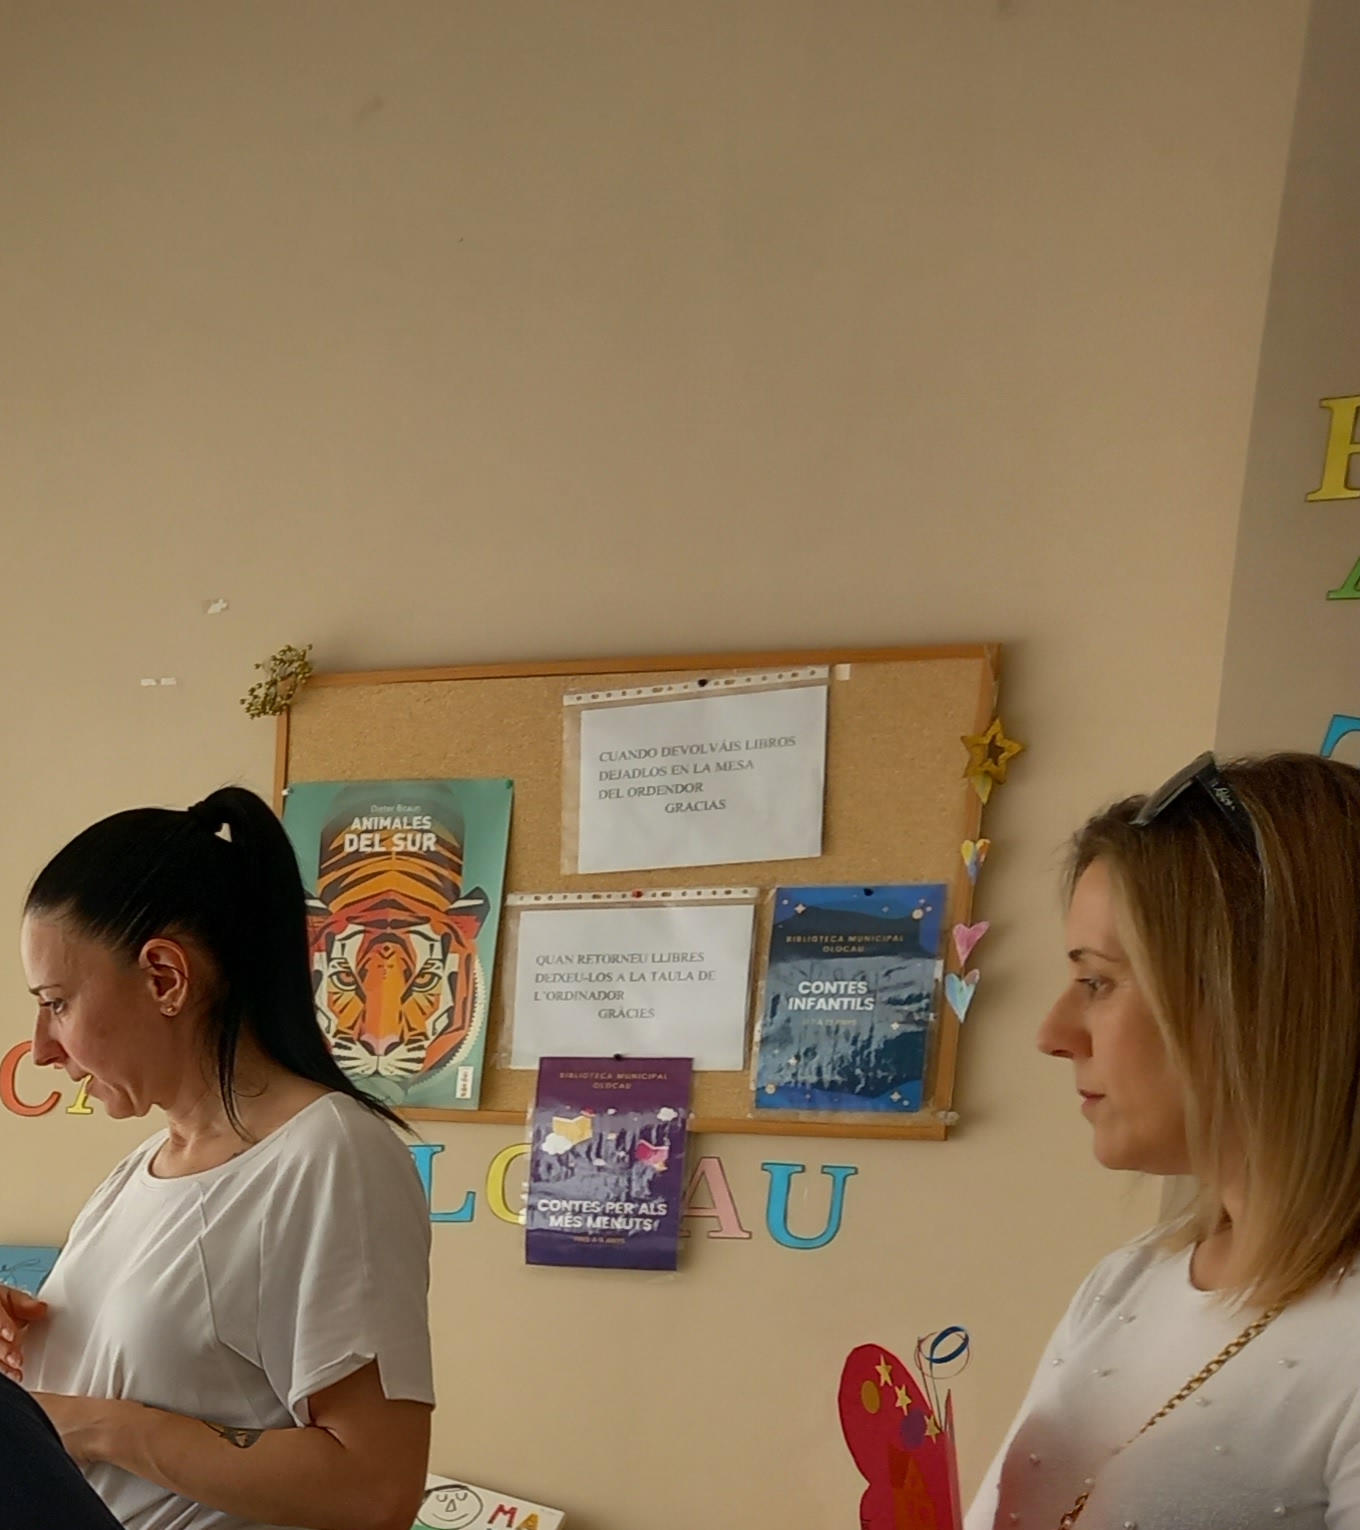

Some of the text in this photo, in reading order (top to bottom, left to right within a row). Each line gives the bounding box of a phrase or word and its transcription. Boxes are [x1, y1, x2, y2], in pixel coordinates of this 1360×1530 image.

[599, 736, 797, 762] CUANDO DEVOLVÁIS LIBROS
[599, 759, 755, 782] DEJADLOS EN LA MESA
[598, 782, 704, 800] DEL ORDENDOR
[664, 799, 726, 814] GRACIAS
[350, 815, 432, 830] ANIMALES
[344, 832, 438, 852] DEL SUR
[786, 934, 904, 943] BIBLIOTECA MUNICIPAL
[822, 945, 865, 953] OLOCAU
[536, 952, 705, 966] QUAN RETORNEU LLIBRES
[535, 970, 716, 984] DEIXEU-LOS A LA TAULA DE
[798, 981, 868, 995] CONTES
[534, 990, 625, 1001] L'ORDINADOR
[787, 997, 875, 1011] INFANTILS
[559, 1072, 613, 1080] BIBLIOTECA
[537, 1199, 668, 1216] CONTES PER ALS
[549, 1214, 653, 1231] MÉS MENUTS
